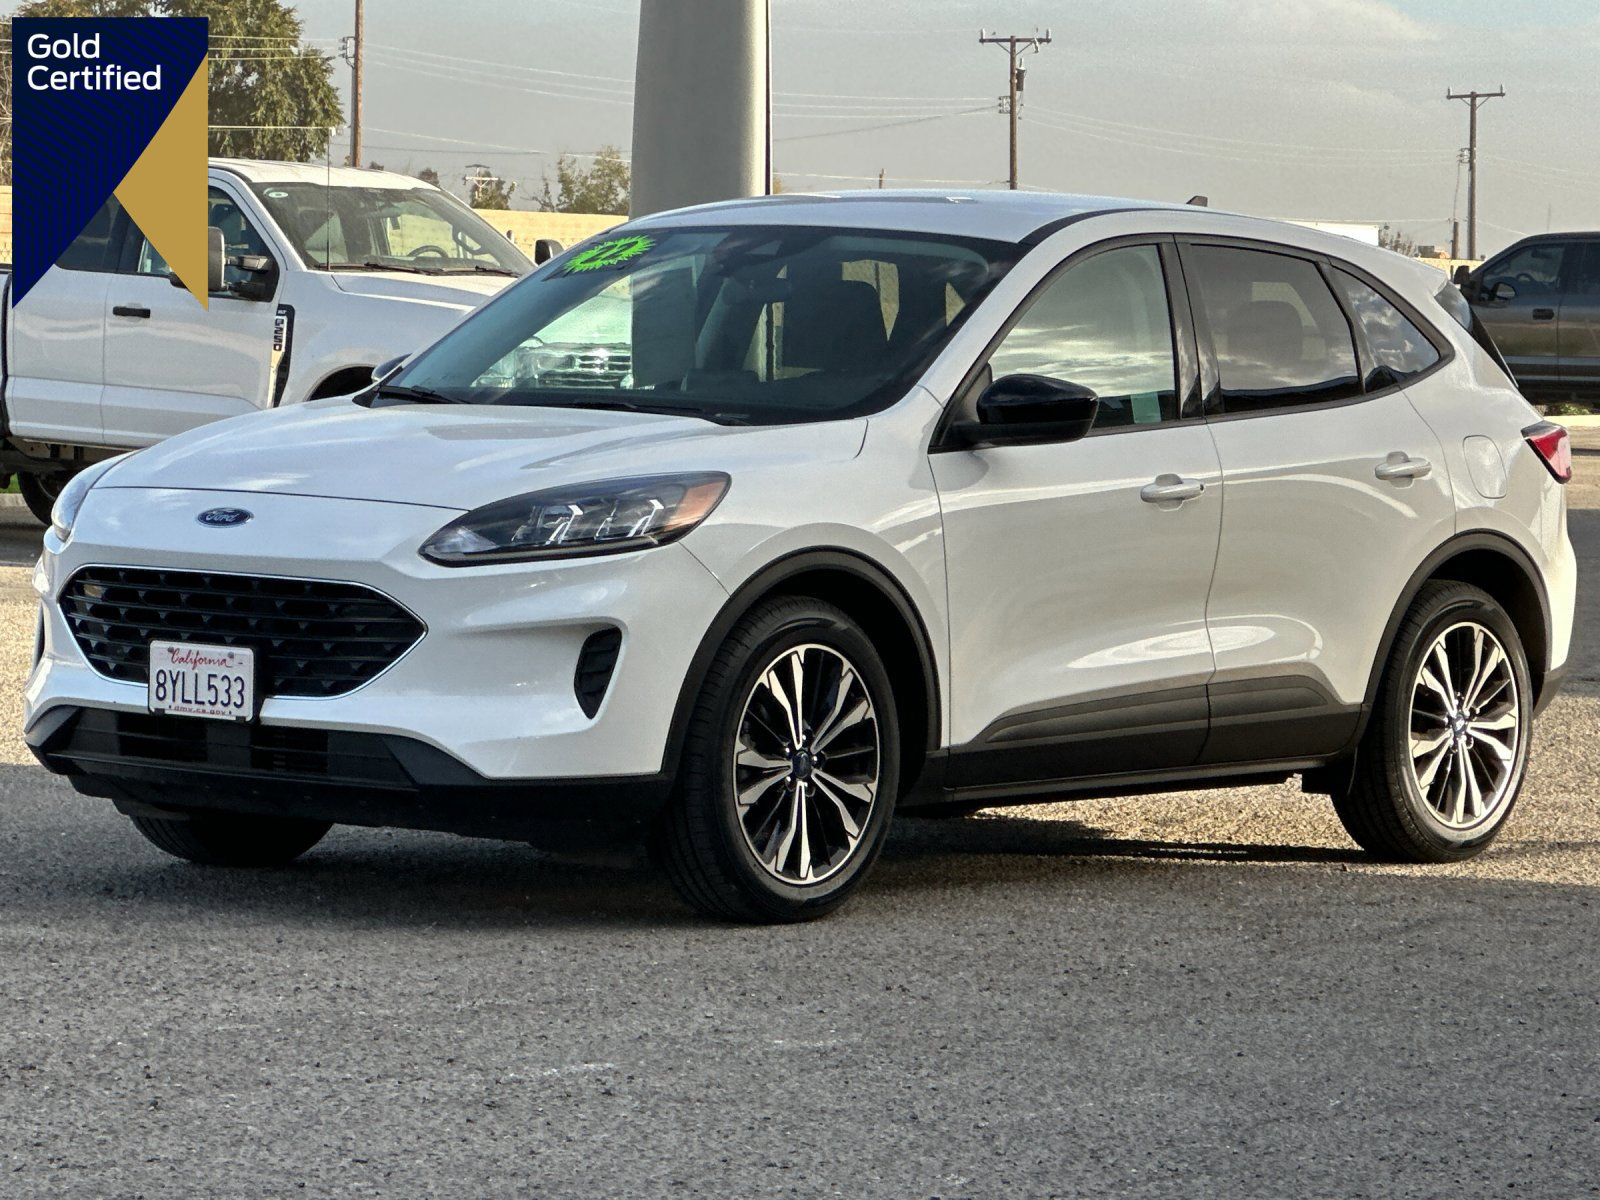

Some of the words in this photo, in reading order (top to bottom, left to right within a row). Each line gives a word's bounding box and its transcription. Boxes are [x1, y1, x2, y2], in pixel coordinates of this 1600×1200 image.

[205, 511, 240, 522] Ford
[171, 648, 232, 670] California
[156, 669, 245, 708] 8YLL533
